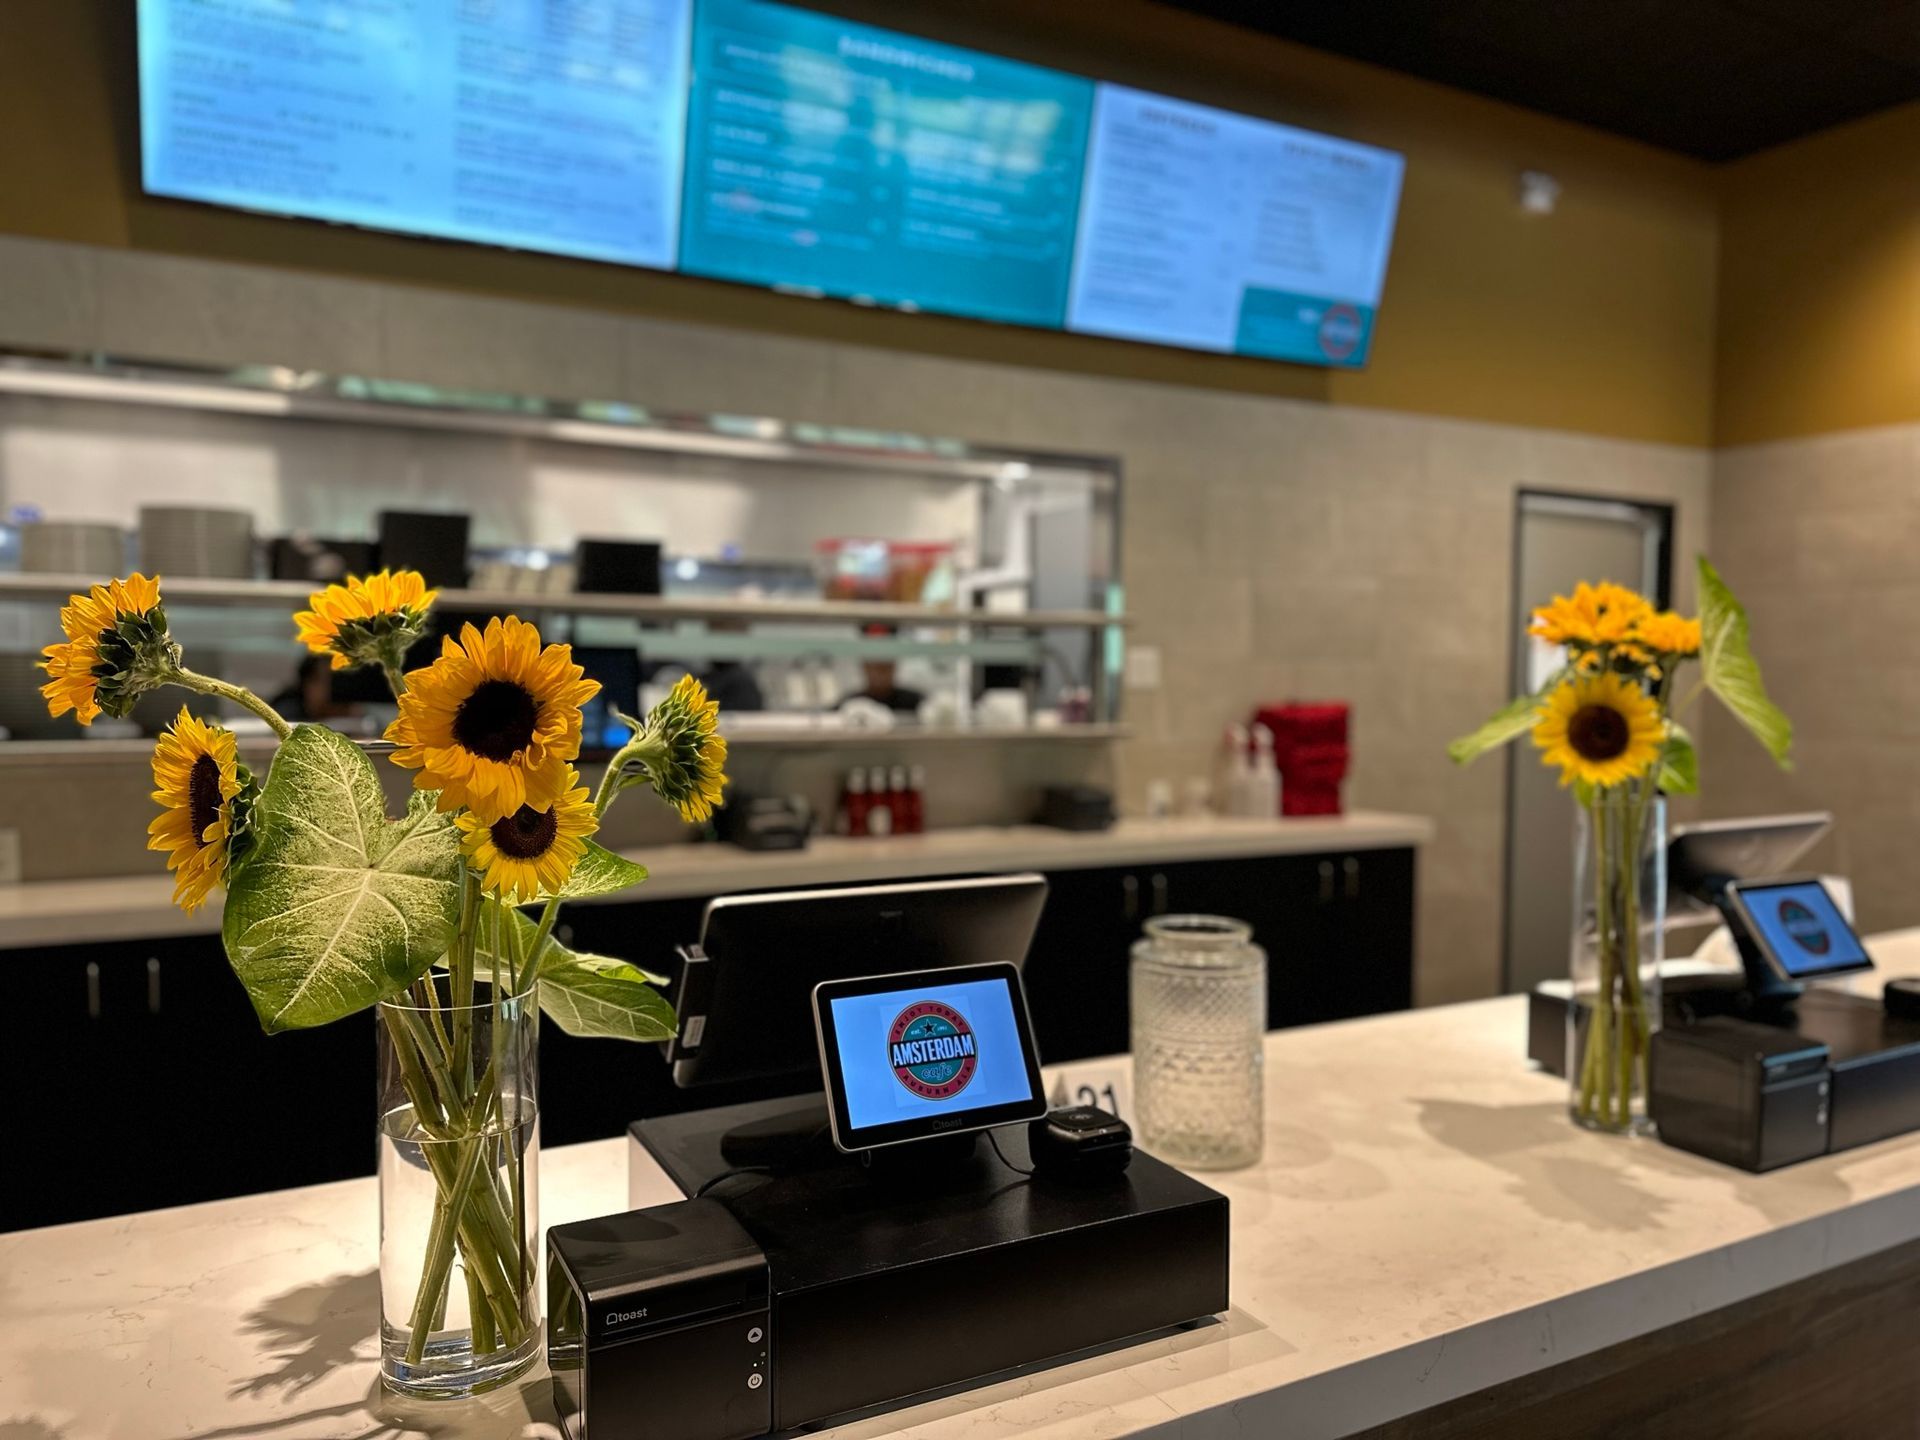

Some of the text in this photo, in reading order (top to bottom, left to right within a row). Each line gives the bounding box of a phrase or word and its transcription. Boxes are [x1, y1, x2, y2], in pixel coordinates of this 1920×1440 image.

[895, 1005, 964, 1035] ENJOY TODAY
[893, 1034, 975, 1067] AMSTERDAM
[903, 1075, 950, 1095] AUBURN
[618, 1307, 648, 1322] toast
